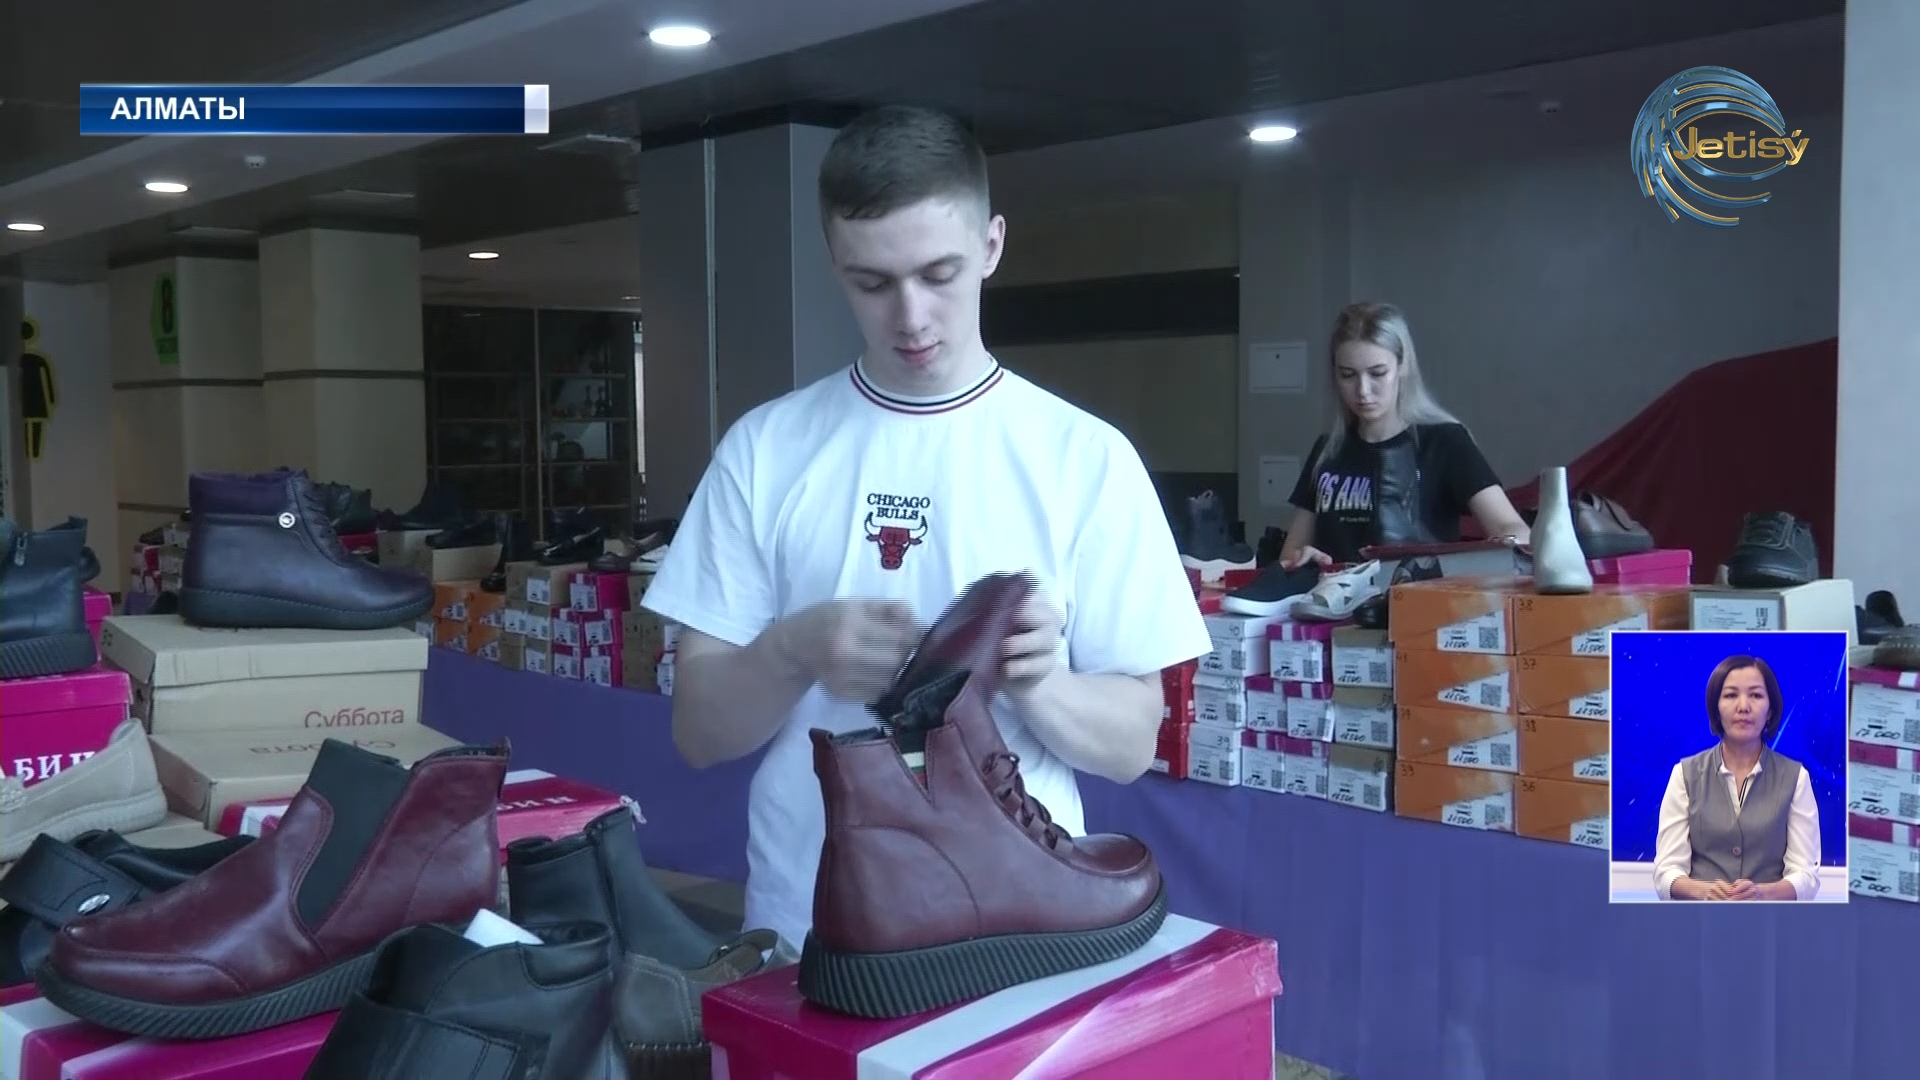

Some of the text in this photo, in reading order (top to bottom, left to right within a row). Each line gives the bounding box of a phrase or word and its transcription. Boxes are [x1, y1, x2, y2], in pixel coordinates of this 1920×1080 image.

[866, 492, 931, 509] CHICAGO
[876, 506, 919, 520] BULLS
[304, 706, 404, 729] Суббота
